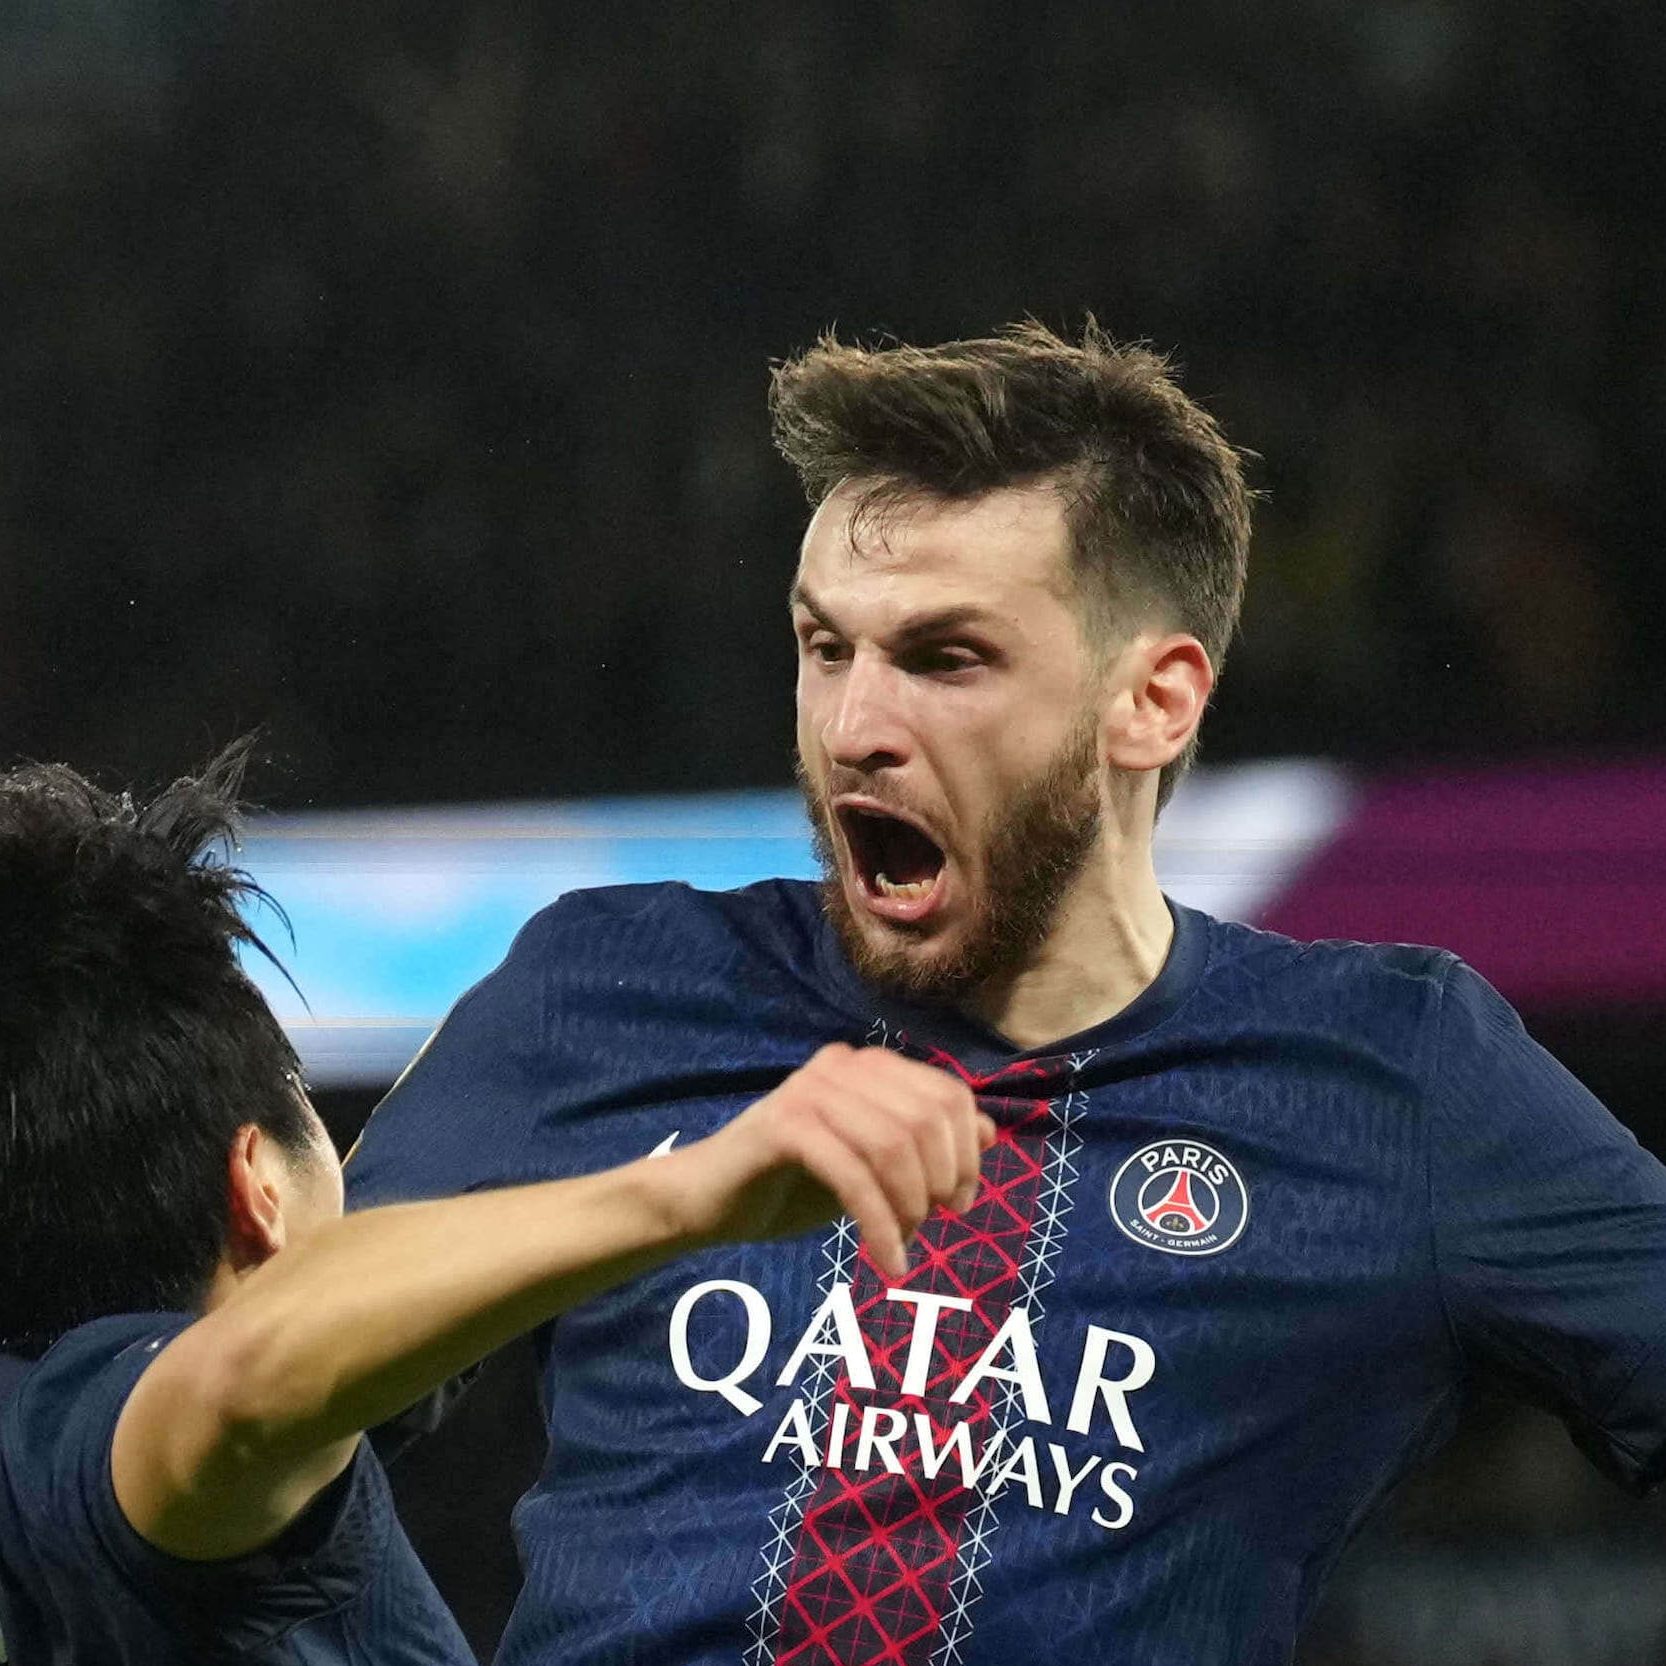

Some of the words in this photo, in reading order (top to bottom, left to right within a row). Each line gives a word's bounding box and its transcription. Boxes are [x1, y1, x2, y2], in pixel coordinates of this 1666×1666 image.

[1140, 1147, 1230, 1185] PARIS
[1130, 1218, 1159, 1242] SAINT
[1167, 1233, 1218, 1247] GERMAIN
[668, 1279, 1156, 1452] QATAR
[762, 1399, 1138, 1530] AIRWAYS
